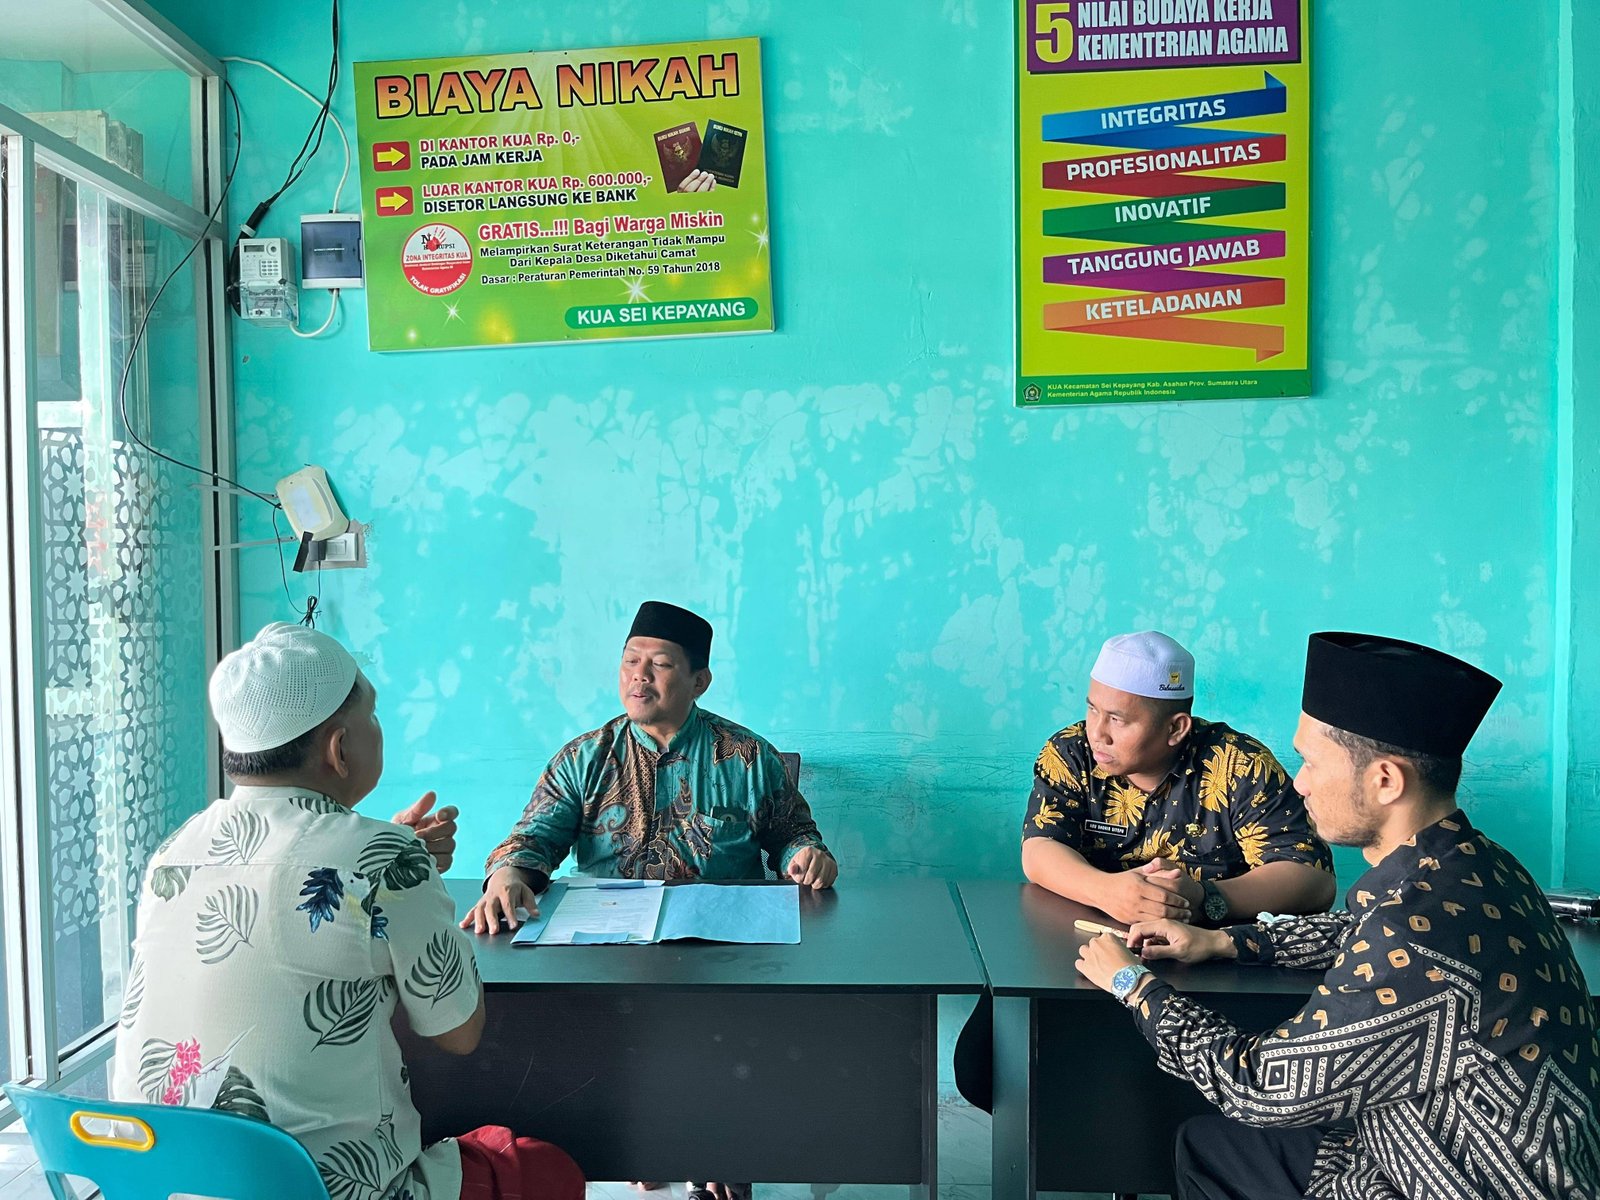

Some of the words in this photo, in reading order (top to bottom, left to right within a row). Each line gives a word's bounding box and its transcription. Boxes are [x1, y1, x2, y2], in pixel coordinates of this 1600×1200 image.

[1078, 1, 1128, 28] NILAI
[1133, 0, 1210, 26] BUDAYA
[1213, 0, 1273, 22] KERJA
[1035, 3, 1073, 63] 5
[1078, 29, 1213, 61] KEMENTERIAN
[1217, 26, 1289, 55] AGAMA
[374, 67, 543, 119] BIAYA
[556, 53, 740, 107] NIKAH
[1101, 99, 1226, 129] INTEGRITAS
[420, 140, 434, 152] DI
[439, 137, 498, 151] KANTOR
[502, 134, 532, 147] KUA
[537, 132, 559, 147] Rp.
[563, 131, 580, 145] 0,-
[421, 155, 458, 168] PADA
[462, 152, 491, 166] JAM
[496, 150, 543, 164] KERJA
[1066, 143, 1261, 181] PROFESIONALITAS
[423, 184, 460, 197] LUAR
[464, 180, 523, 194] KANTOR
[528, 177, 558, 191] KUA
[562, 175, 584, 190] Rp.
[588, 172, 652, 187] 600.000,-
[424, 199, 485, 213] DISETOR
[489, 193, 568, 209] LANGSUNG
[573, 192, 592, 205] KE
[596, 189, 637, 203] BANK
[1115, 196, 1211, 223] INOVATIF
[574, 218, 609, 237] Bagi
[614, 215, 665, 234] Warga
[670, 211, 723, 229] Miskin
[422, 251, 455, 260] INTEGRITAS
[480, 246, 549, 258] Melampirkan
[553, 243, 582, 252] Surat
[586, 239, 649, 251] Keterangan
[652, 236, 682, 247] Tidak
[686, 235, 725, 245] Mampu
[510, 257, 531, 267] Dari
[535, 256, 572, 266] Kepala
[576, 253, 602, 263] Desa
[606, 249, 657, 261] Diketahui
[661, 247, 696, 258] Camat
[1068, 245, 1183, 275] TANGGUNG
[1189, 239, 1260, 267] JAWAB
[410, 276, 429, 292] TOLAK
[429, 272, 467, 294] GRATIFIKASI
[482, 275, 510, 284] Dasar
[519, 271, 566, 282] Peraturan
[569, 267, 626, 279] Pemerintah
[628, 266, 645, 276] No.
[648, 265, 660, 275] 59
[663, 263, 693, 274] Tahun
[696, 261, 720, 272] 2018
[577, 309, 615, 325] KUA
[619, 307, 647, 322] SEI
[652, 301, 746, 321] KEPAYANG
[1086, 289, 1242, 320] KETELADANAN
[1113, 382, 1146, 390] Kepayang
